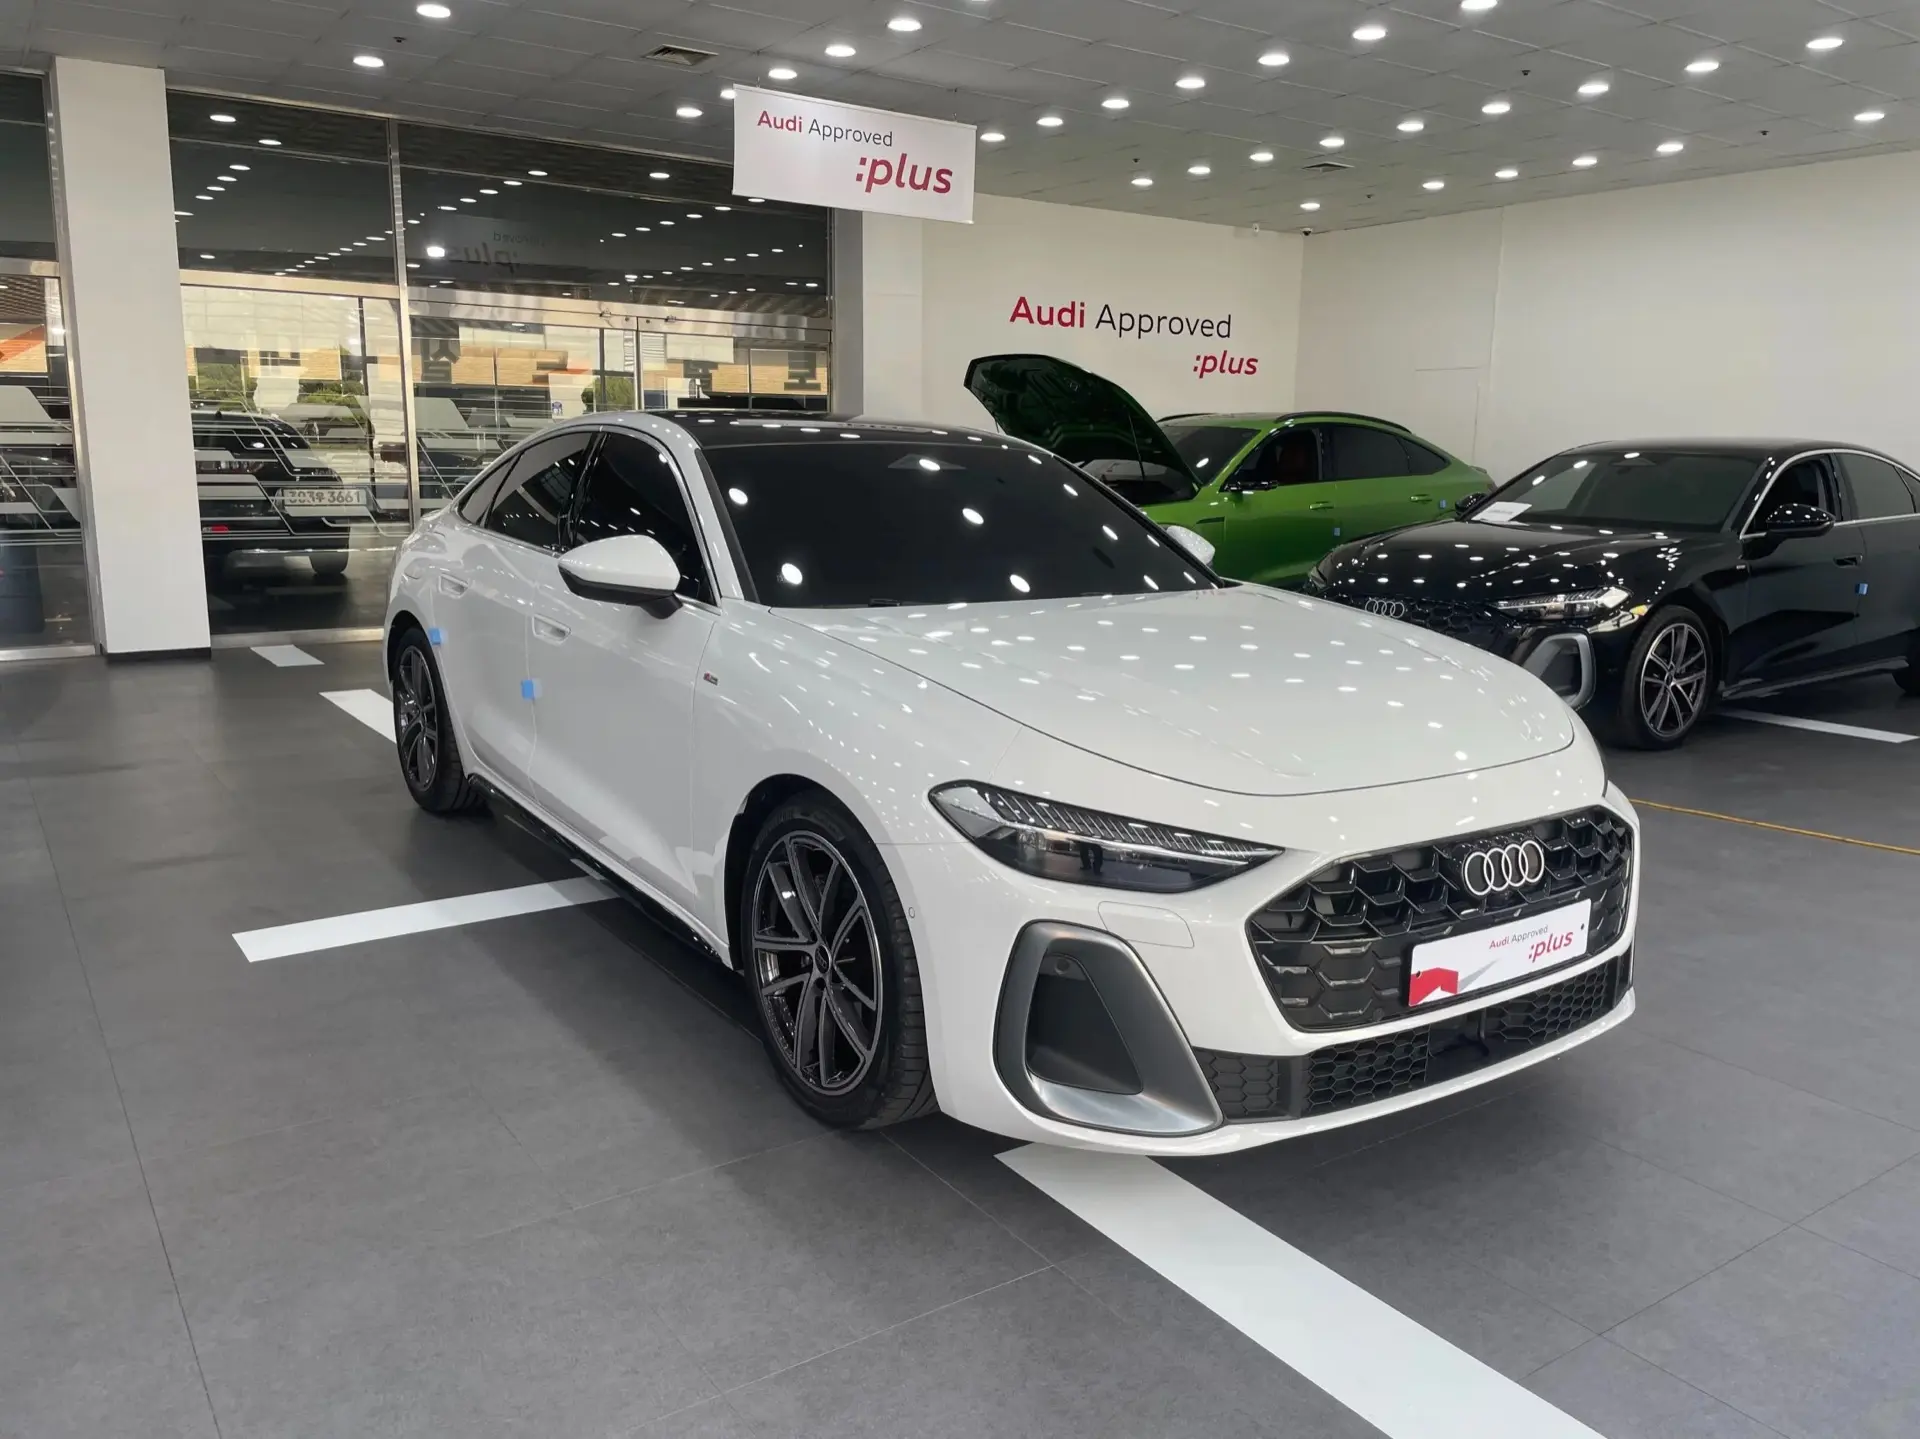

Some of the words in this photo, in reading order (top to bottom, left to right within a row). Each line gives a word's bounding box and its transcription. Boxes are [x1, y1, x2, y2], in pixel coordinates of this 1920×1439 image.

[757, 110, 803, 133] Audi
[808, 118, 893, 147] Approved
[855, 153, 953, 194] :plus
[1009, 296, 1085, 328] Audi
[1095, 304, 1231, 339] Approved
[1193, 350, 1259, 379] :plus
[1489, 938, 1510, 950] Audi
[1511, 925, 1549, 944] Approved
[1528, 931, 1574, 963] :plus
